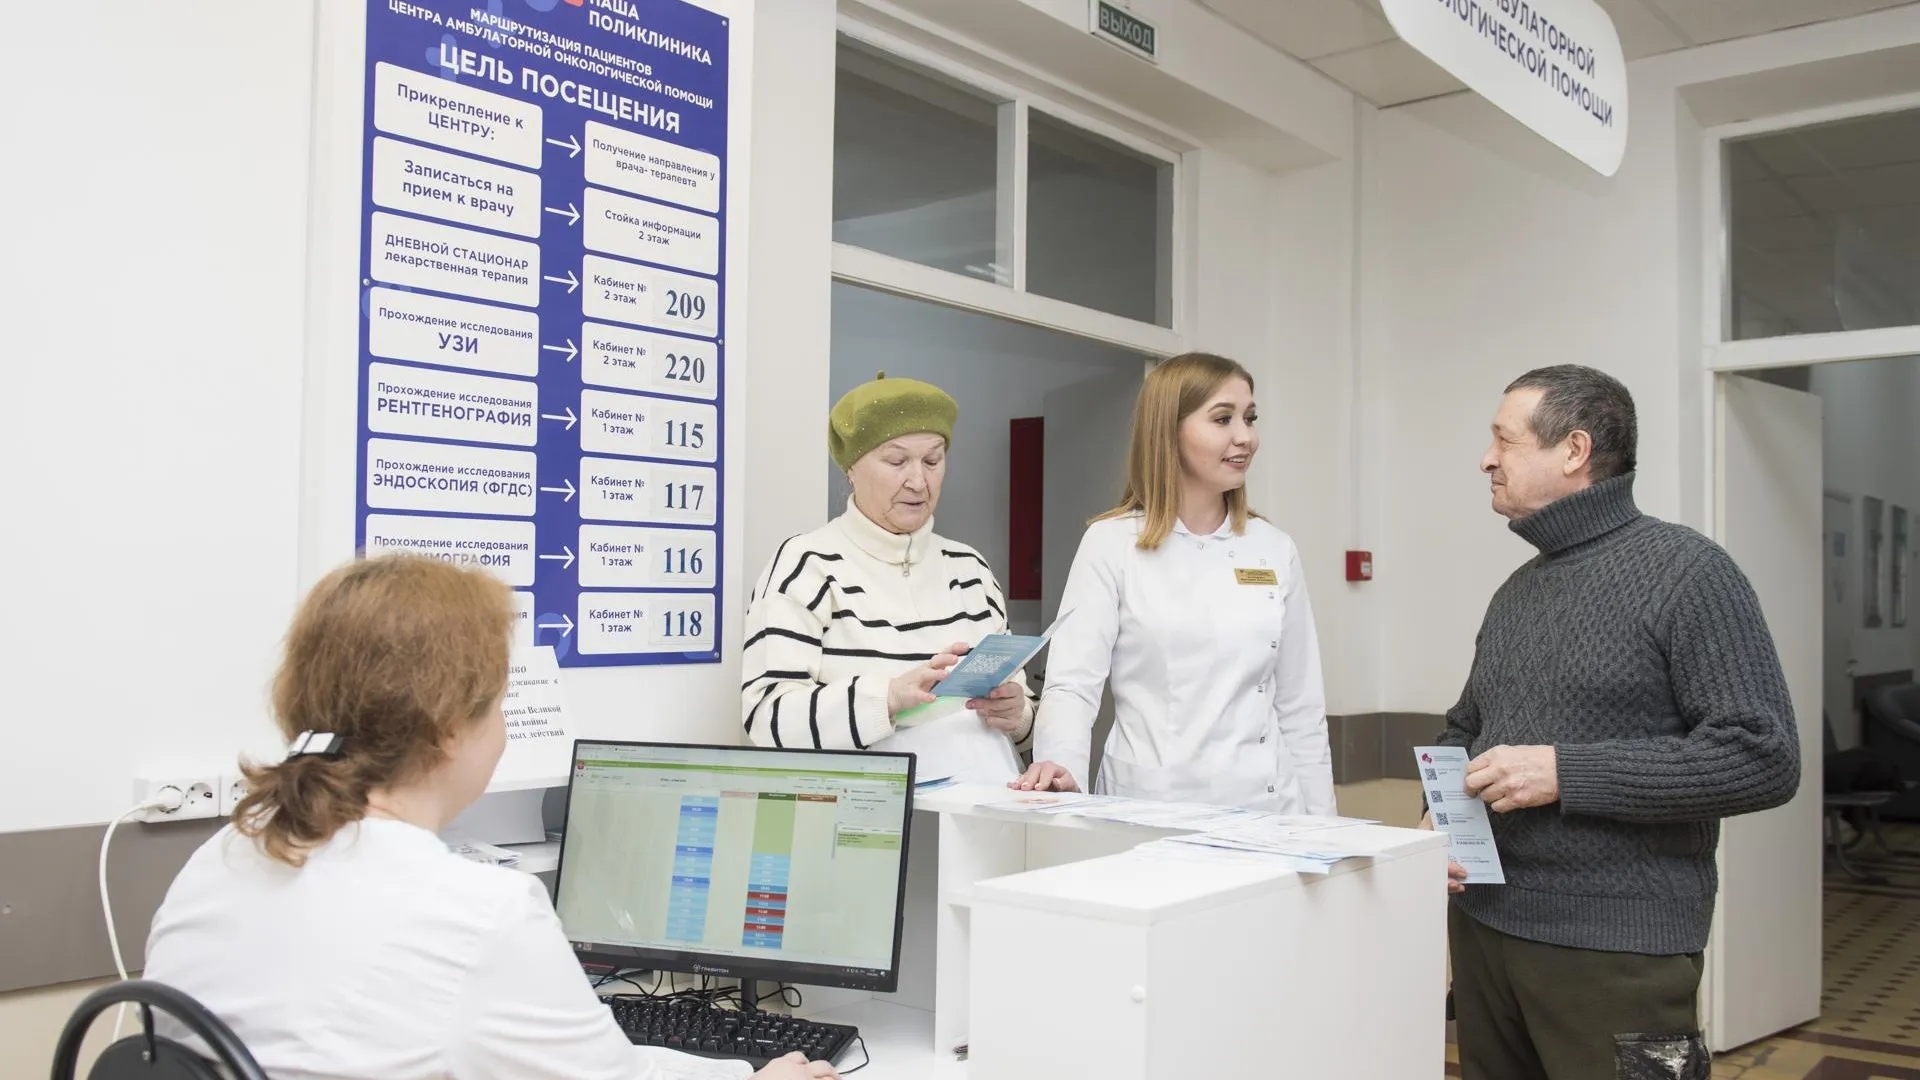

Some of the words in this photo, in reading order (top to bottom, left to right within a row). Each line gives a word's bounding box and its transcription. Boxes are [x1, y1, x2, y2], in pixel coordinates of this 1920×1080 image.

[470, 8, 581, 52] МАРШРУТИЗАЦИЯ
[584, 45, 652, 76] ПАЦИЕНТОВ
[589, 10, 712, 65] ПОЛИКЛИНИКА
[1100, 7, 1152, 50] ВЫХОД
[389, 0, 442, 25] ЦЕНТРА
[446, 17, 551, 59] АМБУЛАТОРНОЙ
[554, 50, 662, 92] ОНКОЛОГИЧЕСКОЙ
[665, 85, 713, 110] ПОМОЩИ
[440, 43, 514, 85] ЦЕЛЬ
[522, 67, 680, 134] ПОСЕЩЕНИЯ
[1551, 63, 1612, 128] ПОМОЩИ
[397, 83, 511, 126] Прикрепление
[515, 118, 523, 129] к
[428, 112, 495, 140] ЦЕНТРУ:
[592, 139, 646, 161] Получение
[649, 156, 708, 178] направления
[710, 172, 715, 181] у
[616, 160, 648, 174] врача-
[650, 169, 697, 188] терапевта
[404, 160, 492, 191] Записаться
[496, 184, 513, 196] на
[402, 182, 451, 202] прием
[457, 194, 466, 205] к
[470, 197, 514, 217] врачу
[604, 209, 640, 226] Стойка
[642, 219, 701, 240] информации
[638, 231, 644, 240] 2
[647, 233, 670, 245] этаж
[385, 234, 449, 256] ДНЕВНОЙ
[452, 247, 529, 270] СТАЦИОНАР
[385, 252, 478, 277] лекарственная
[481, 269, 528, 285] терапия
[594, 275, 635, 291] Кабинет
[637, 284, 647, 292] №
[604, 290, 610, 300] 2
[613, 293, 637, 305] этаж
[665, 290, 706, 320] 209
[379, 307, 457, 328] Прохождение
[460, 320, 533, 340] исследования
[438, 332, 478, 354] УЗИ
[593, 340, 634, 355] Кабинет
[636, 347, 646, 356] №
[603, 356, 610, 365] 2
[612, 358, 636, 369] этаж
[665, 353, 705, 383] 220
[377, 382, 456, 401] Прохождение
[459, 393, 532, 409] исследования
[377, 398, 532, 427] РЕНТГЕНОГРАФИЯ
[591, 408, 632, 421] Кабинет
[635, 414, 645, 422] №
[602, 423, 607, 432] 1
[610, 425, 634, 435] этаж
[665, 420, 704, 449] 115
[376, 459, 454, 474] Прохождение
[457, 467, 531, 480] исследования
[591, 475, 632, 487] Кабинет
[635, 479, 645, 488] №
[373, 473, 478, 493] ЭНДОСКОПИЯ
[483, 481, 533, 497] (ФГДС)
[602, 490, 607, 499] 1
[609, 491, 634, 501] этаж
[664, 482, 704, 510] 117
[374, 536, 452, 548] Прохождение
[455, 540, 529, 551] исследования
[590, 542, 631, 553] Кабинет
[634, 544, 644, 553] №
[602, 556, 606, 566] 1
[608, 557, 633, 567] этаж
[663, 547, 703, 574] 116
[589, 609, 630, 619] Кабинет
[633, 609, 643, 619] №
[600, 623, 605, 632] 1
[608, 623, 632, 632] этаж
[663, 610, 702, 637] 118
